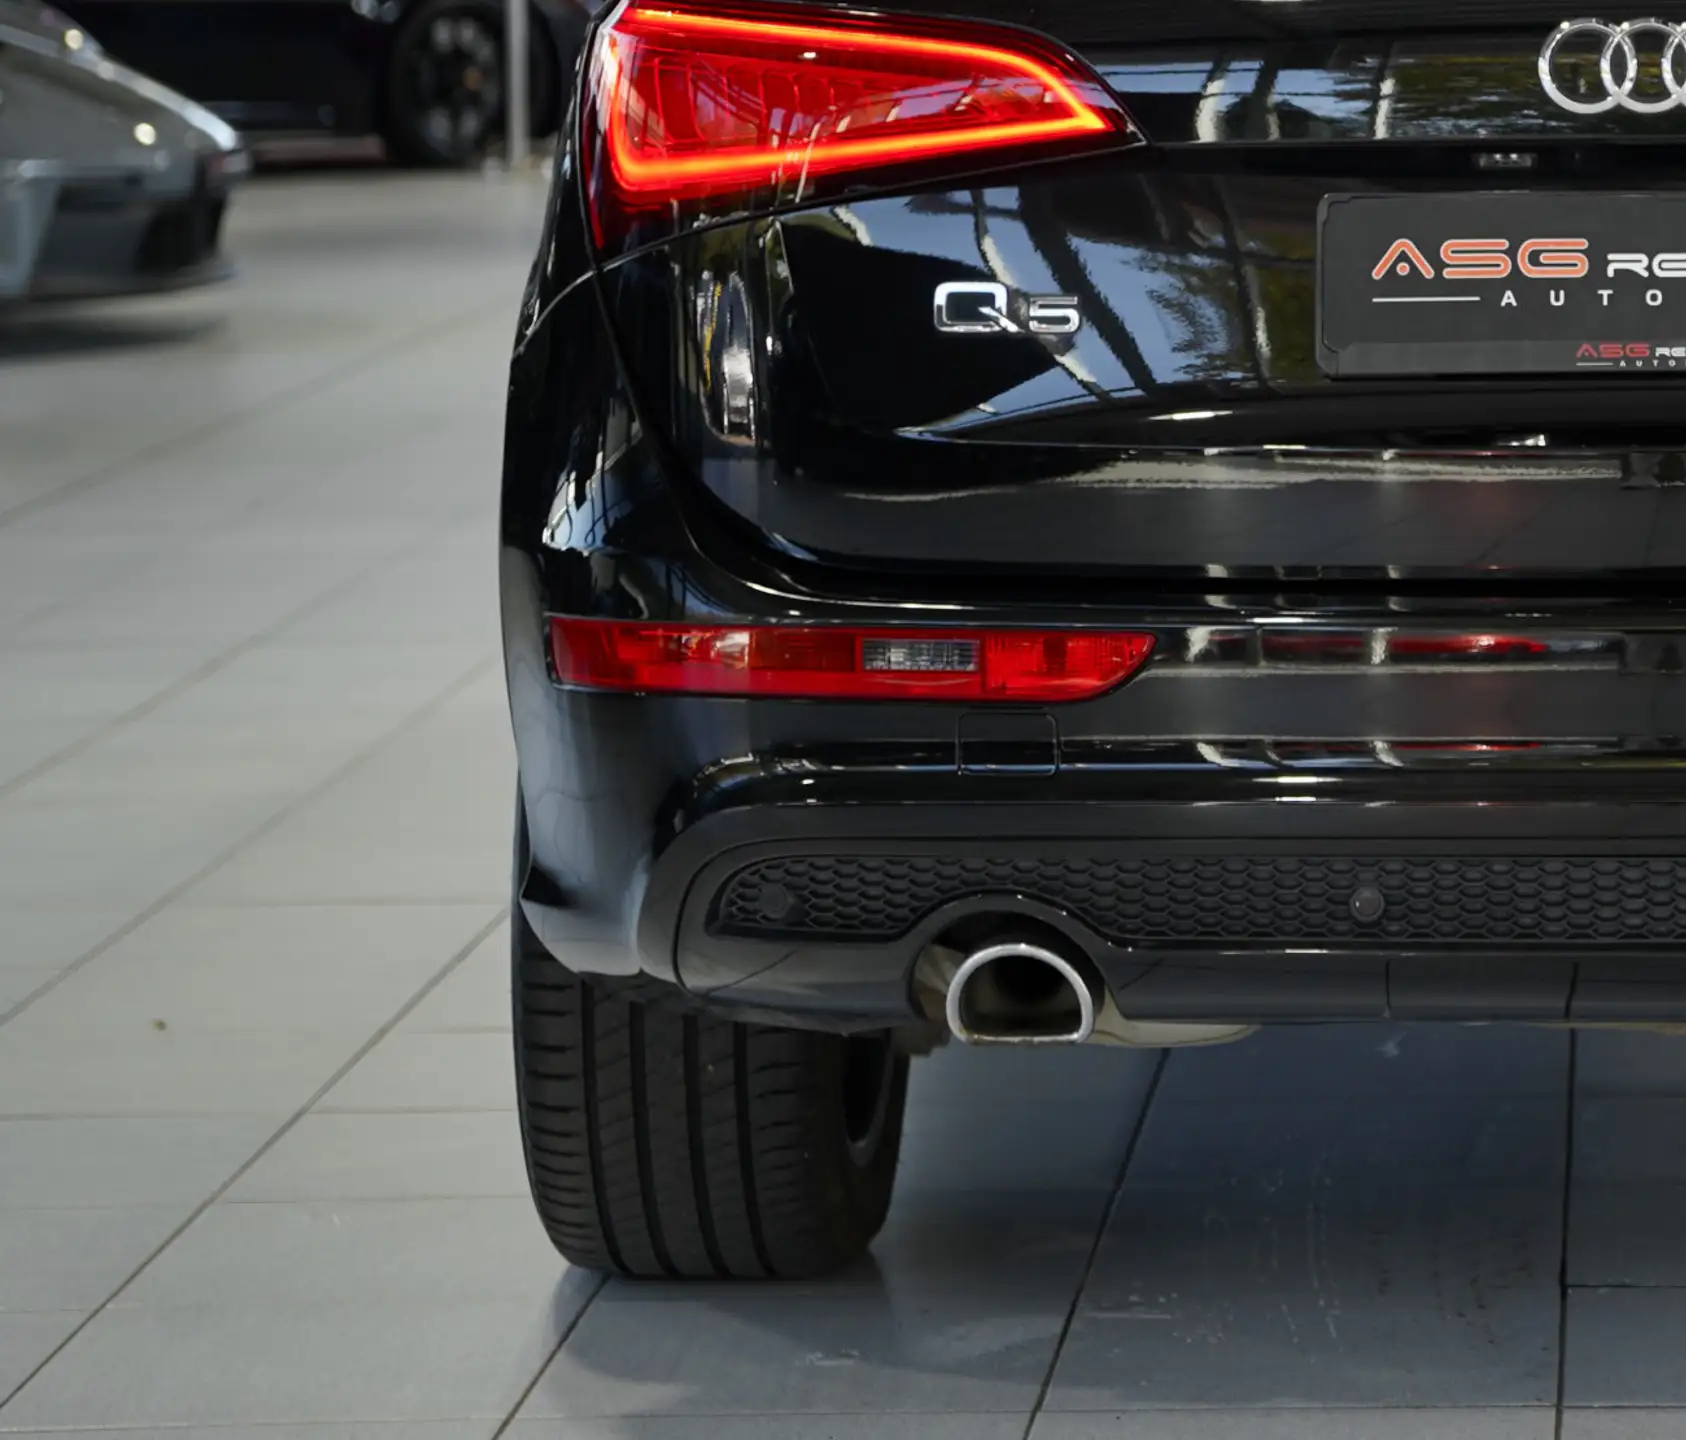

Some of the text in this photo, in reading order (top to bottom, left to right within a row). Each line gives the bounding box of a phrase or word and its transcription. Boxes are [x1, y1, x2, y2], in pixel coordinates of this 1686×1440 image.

[1371, 238, 1590, 280] ASG
[933, 281, 1081, 333] Q5
[1576, 343, 1651, 359] ASG
